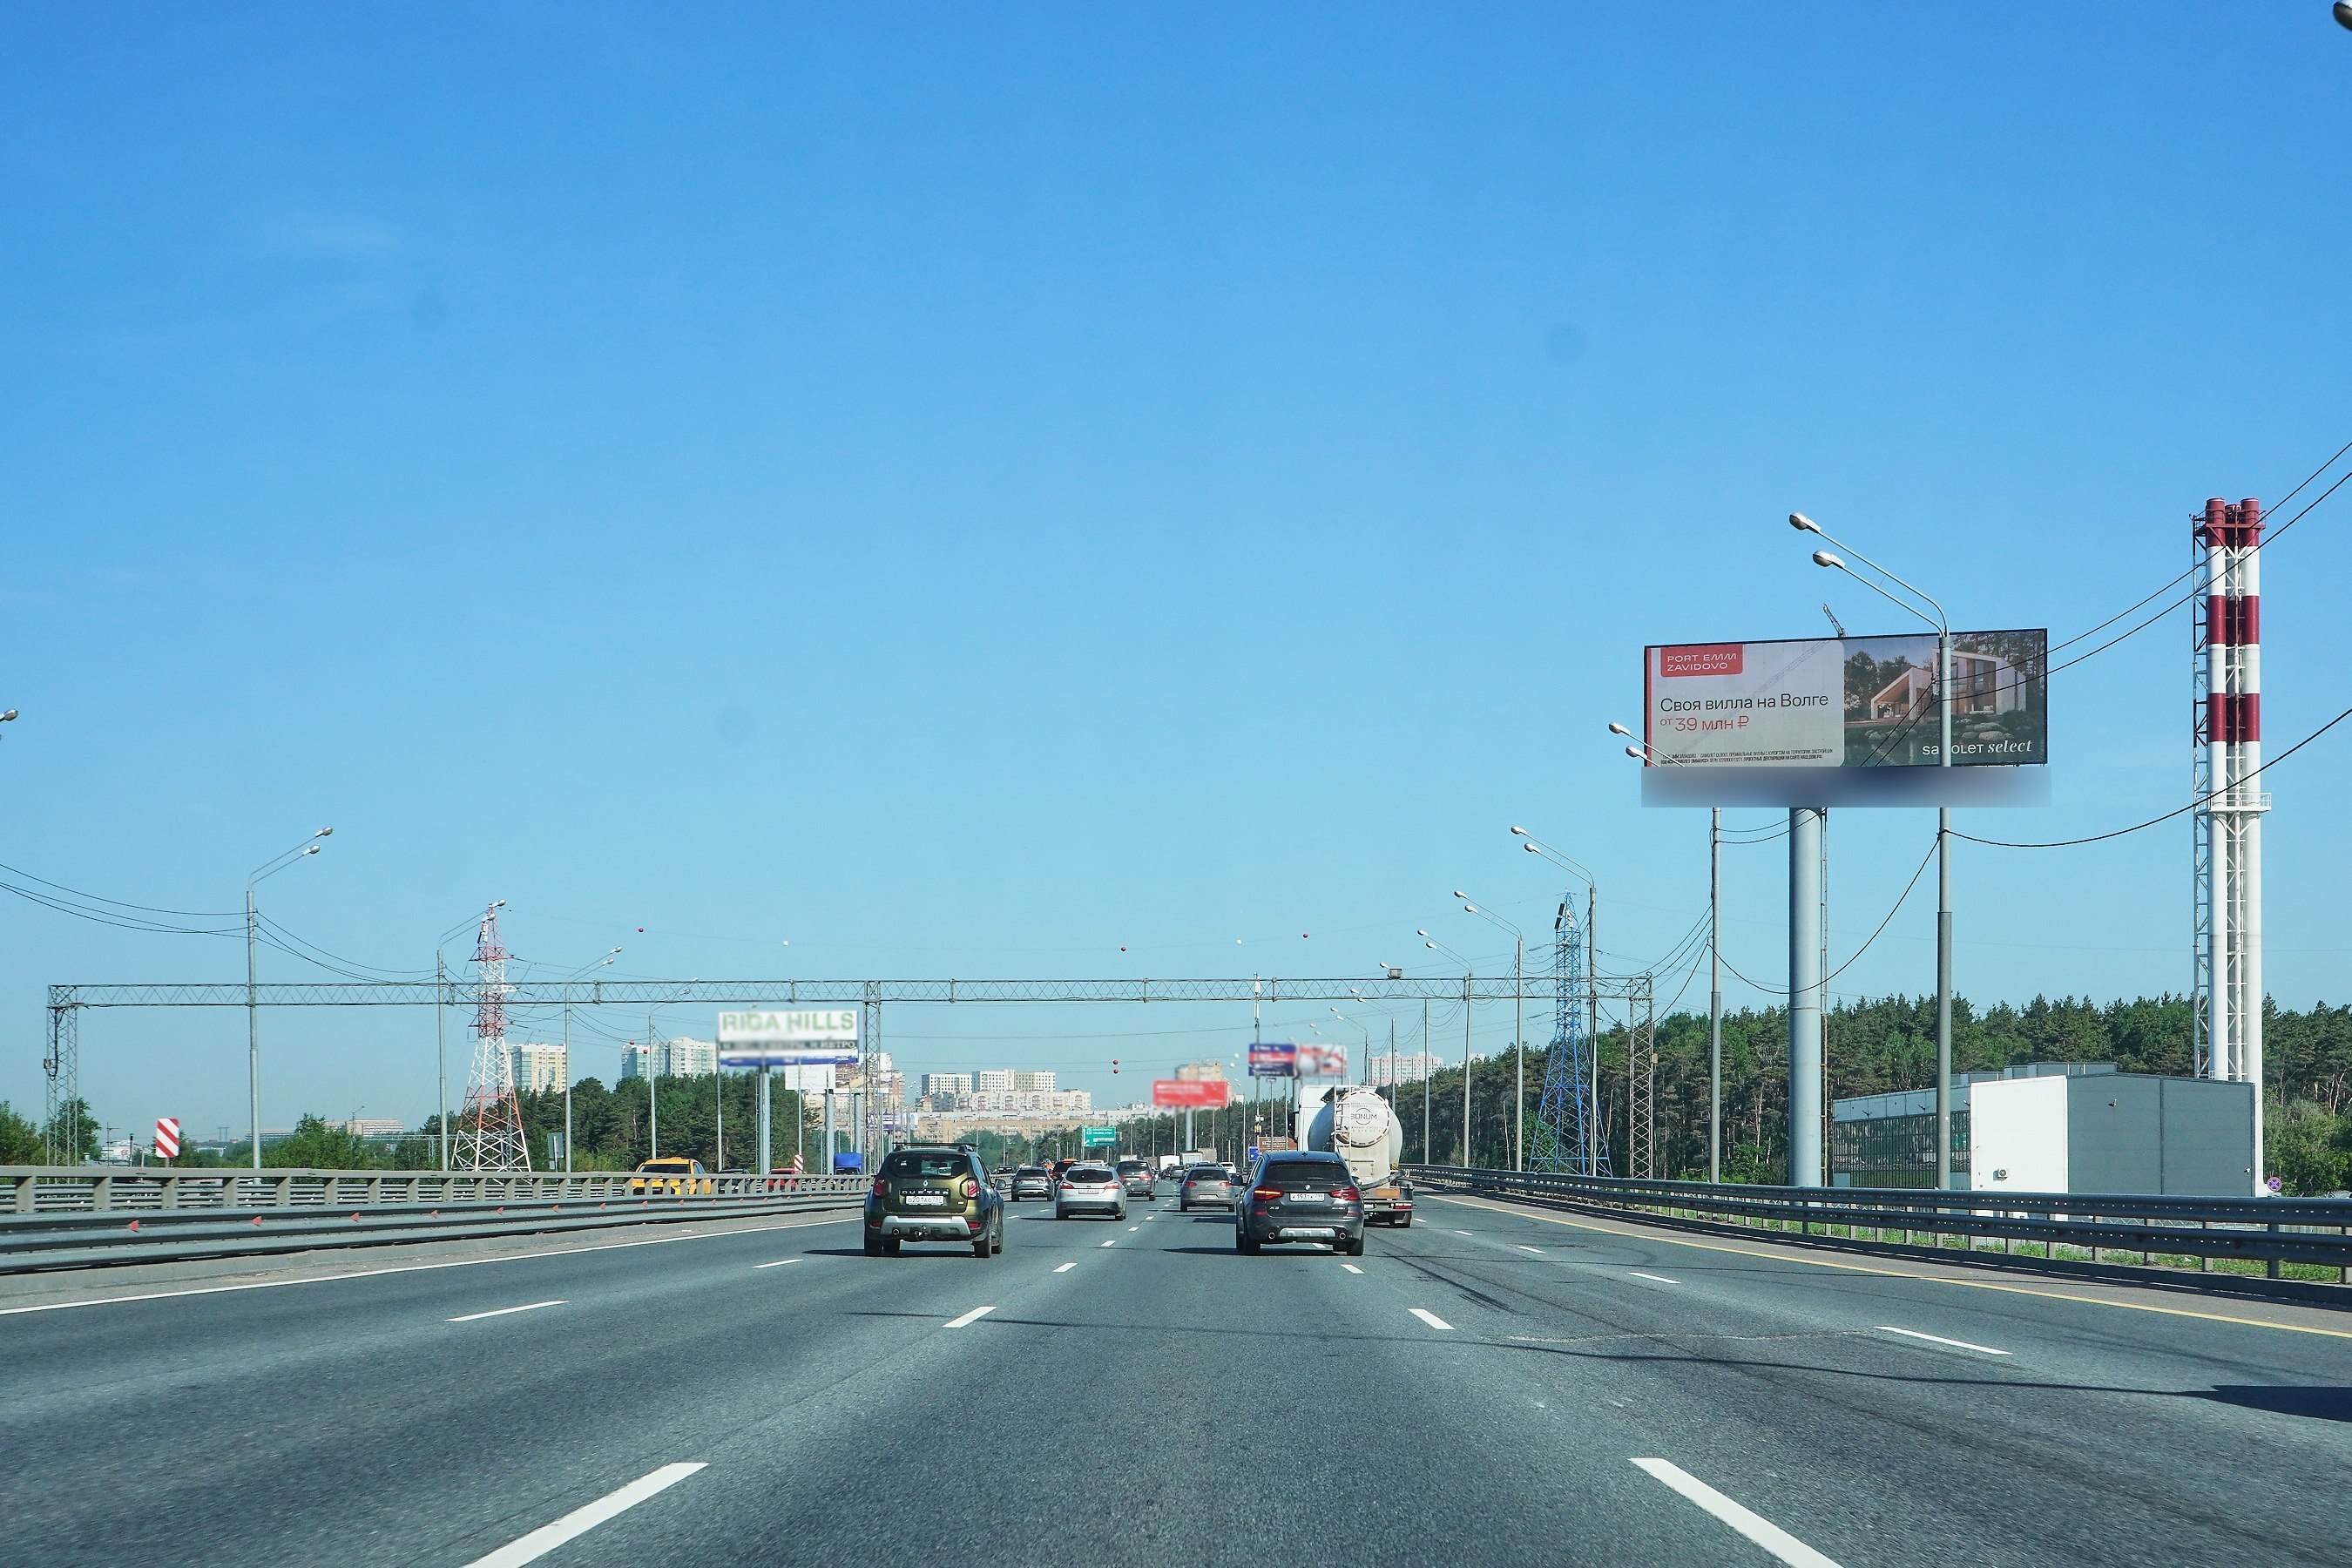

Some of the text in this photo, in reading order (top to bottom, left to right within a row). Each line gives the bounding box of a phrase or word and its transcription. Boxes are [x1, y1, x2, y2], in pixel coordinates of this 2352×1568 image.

[1703, 652, 1737, 661] EMM
[1666, 662, 1728, 672] ZAVIDOVO
[1660, 693, 1828, 712] Своя вилла на Волге
[1659, 718, 1673, 727] от
[1674, 717, 1698, 732] 39
[1701, 719, 1734, 731] млн
[1987, 740, 2033, 754] select
[787, 1012, 855, 1031] HILLS
